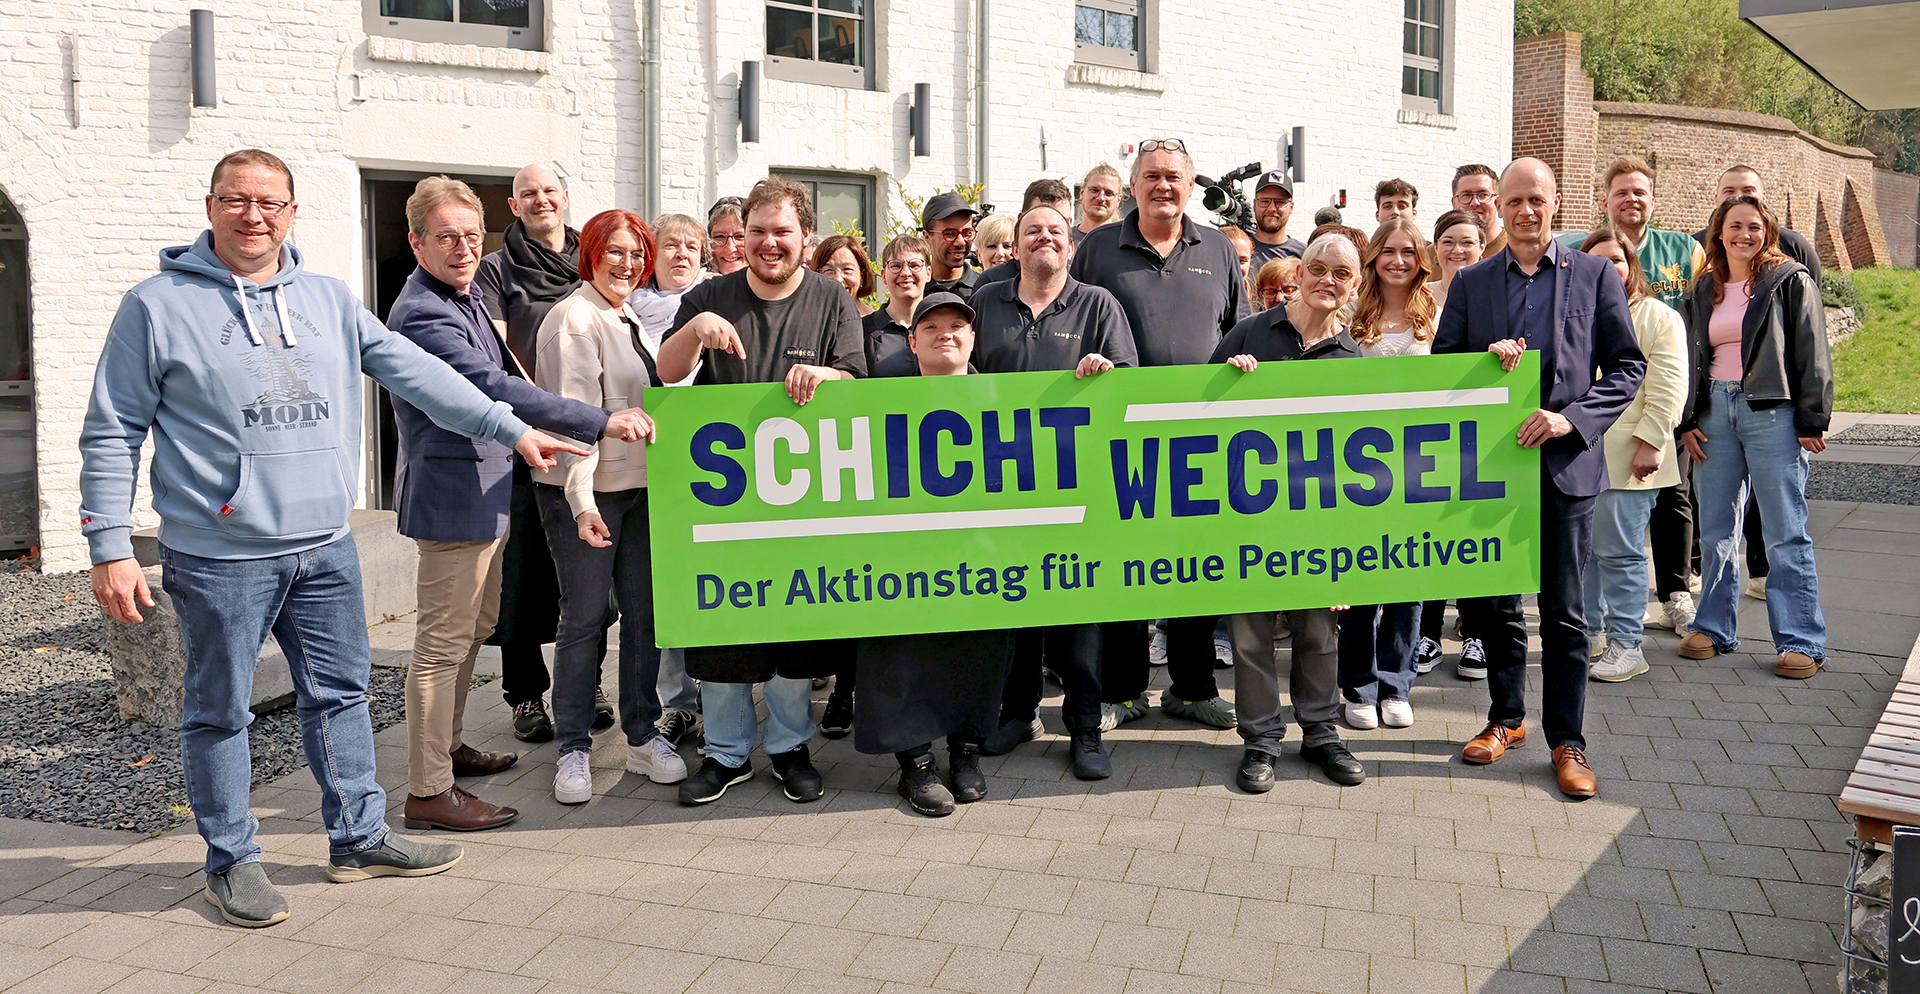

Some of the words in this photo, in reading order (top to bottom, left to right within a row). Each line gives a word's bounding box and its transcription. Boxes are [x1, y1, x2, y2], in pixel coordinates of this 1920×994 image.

[1651, 278, 1688, 294] CLUB
[304, 319, 322, 338] HAT
[241, 401, 329, 428] MOIN
[299, 421, 318, 429] STRAND
[690, 407, 1091, 507] SCHICHT
[1110, 420, 1506, 520] WECHSEL
[696, 573, 773, 611] Der
[785, 563, 1030, 602] Aktionstag
[1041, 553, 1102, 592] für
[1123, 552, 1225, 588] neue
[1239, 531, 1502, 583] Perspektiven
